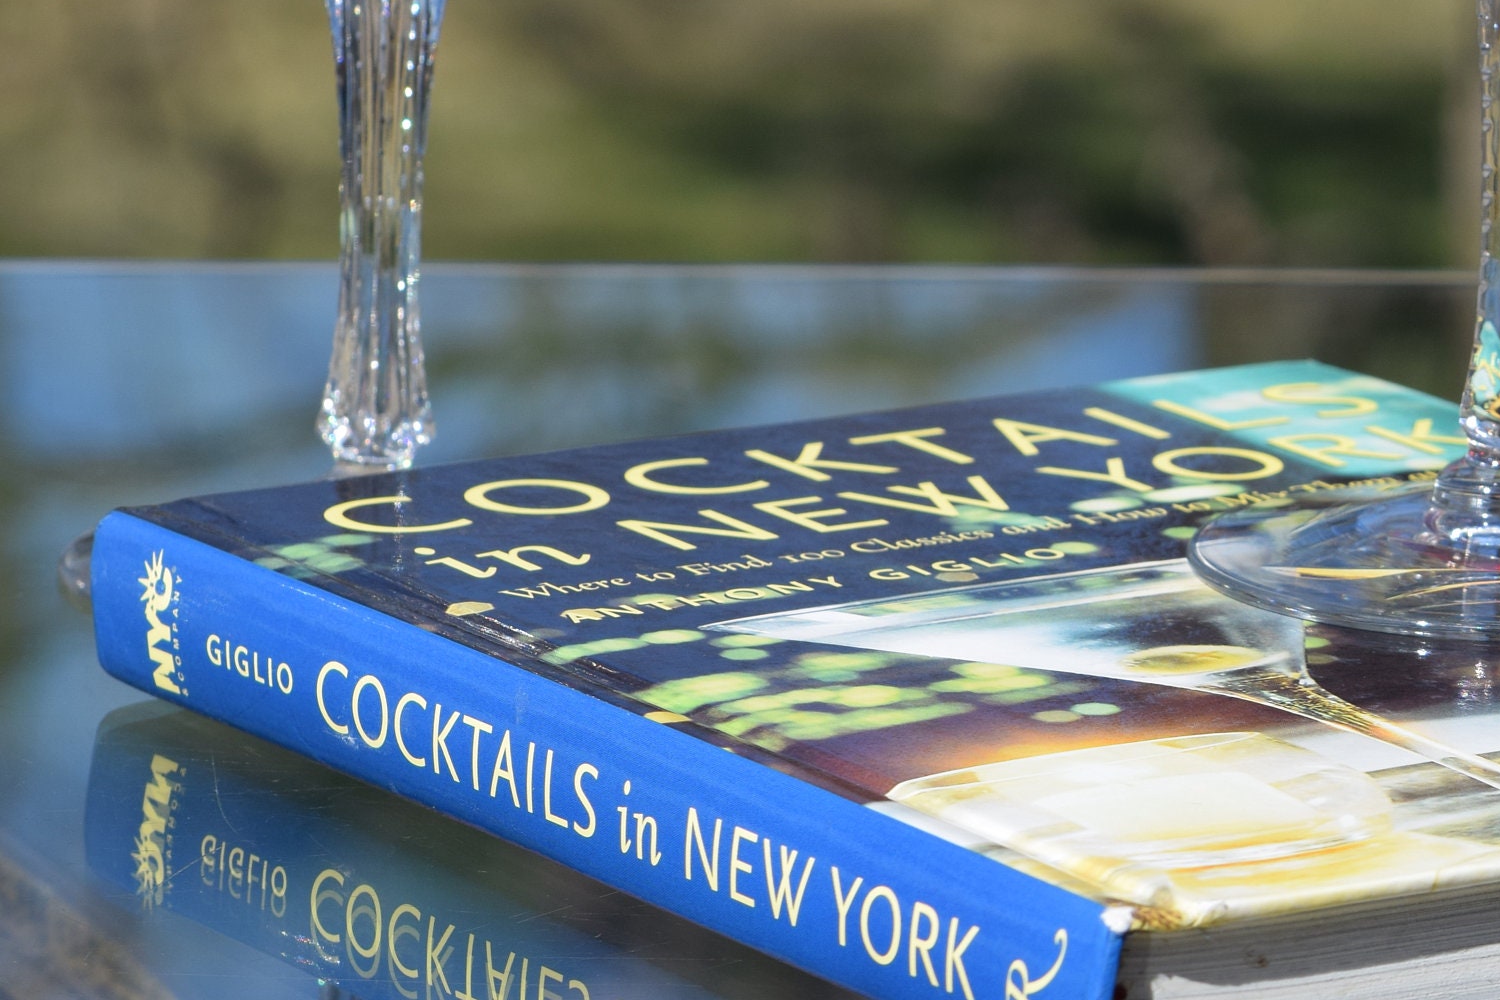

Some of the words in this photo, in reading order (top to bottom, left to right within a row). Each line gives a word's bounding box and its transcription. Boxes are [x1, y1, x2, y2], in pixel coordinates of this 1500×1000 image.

[323, 383, 1378, 534] COCKTAILS
[413, 543, 591, 579] in
[616, 475, 1009, 551] NEW
[1036, 417, 1470, 492] YORK
[499, 576, 632, 600] Where
[635, 570, 676, 583] to
[675, 554, 773, 576] Find
[850, 526, 995, 554] Classics
[1001, 515, 1072, 537] and
[1073, 505, 1167, 525] How
[1171, 498, 1211, 513] to
[564, 574, 844, 625] ANTHONY
[868, 546, 1066, 581] GIGLIO
[206, 633, 293, 695] GIGLIO
[315, 660, 600, 839] COCKTAILS
[616, 780, 662, 867] in
[683, 807, 815, 927] NEW
[831, 865, 981, 1000] YORK
